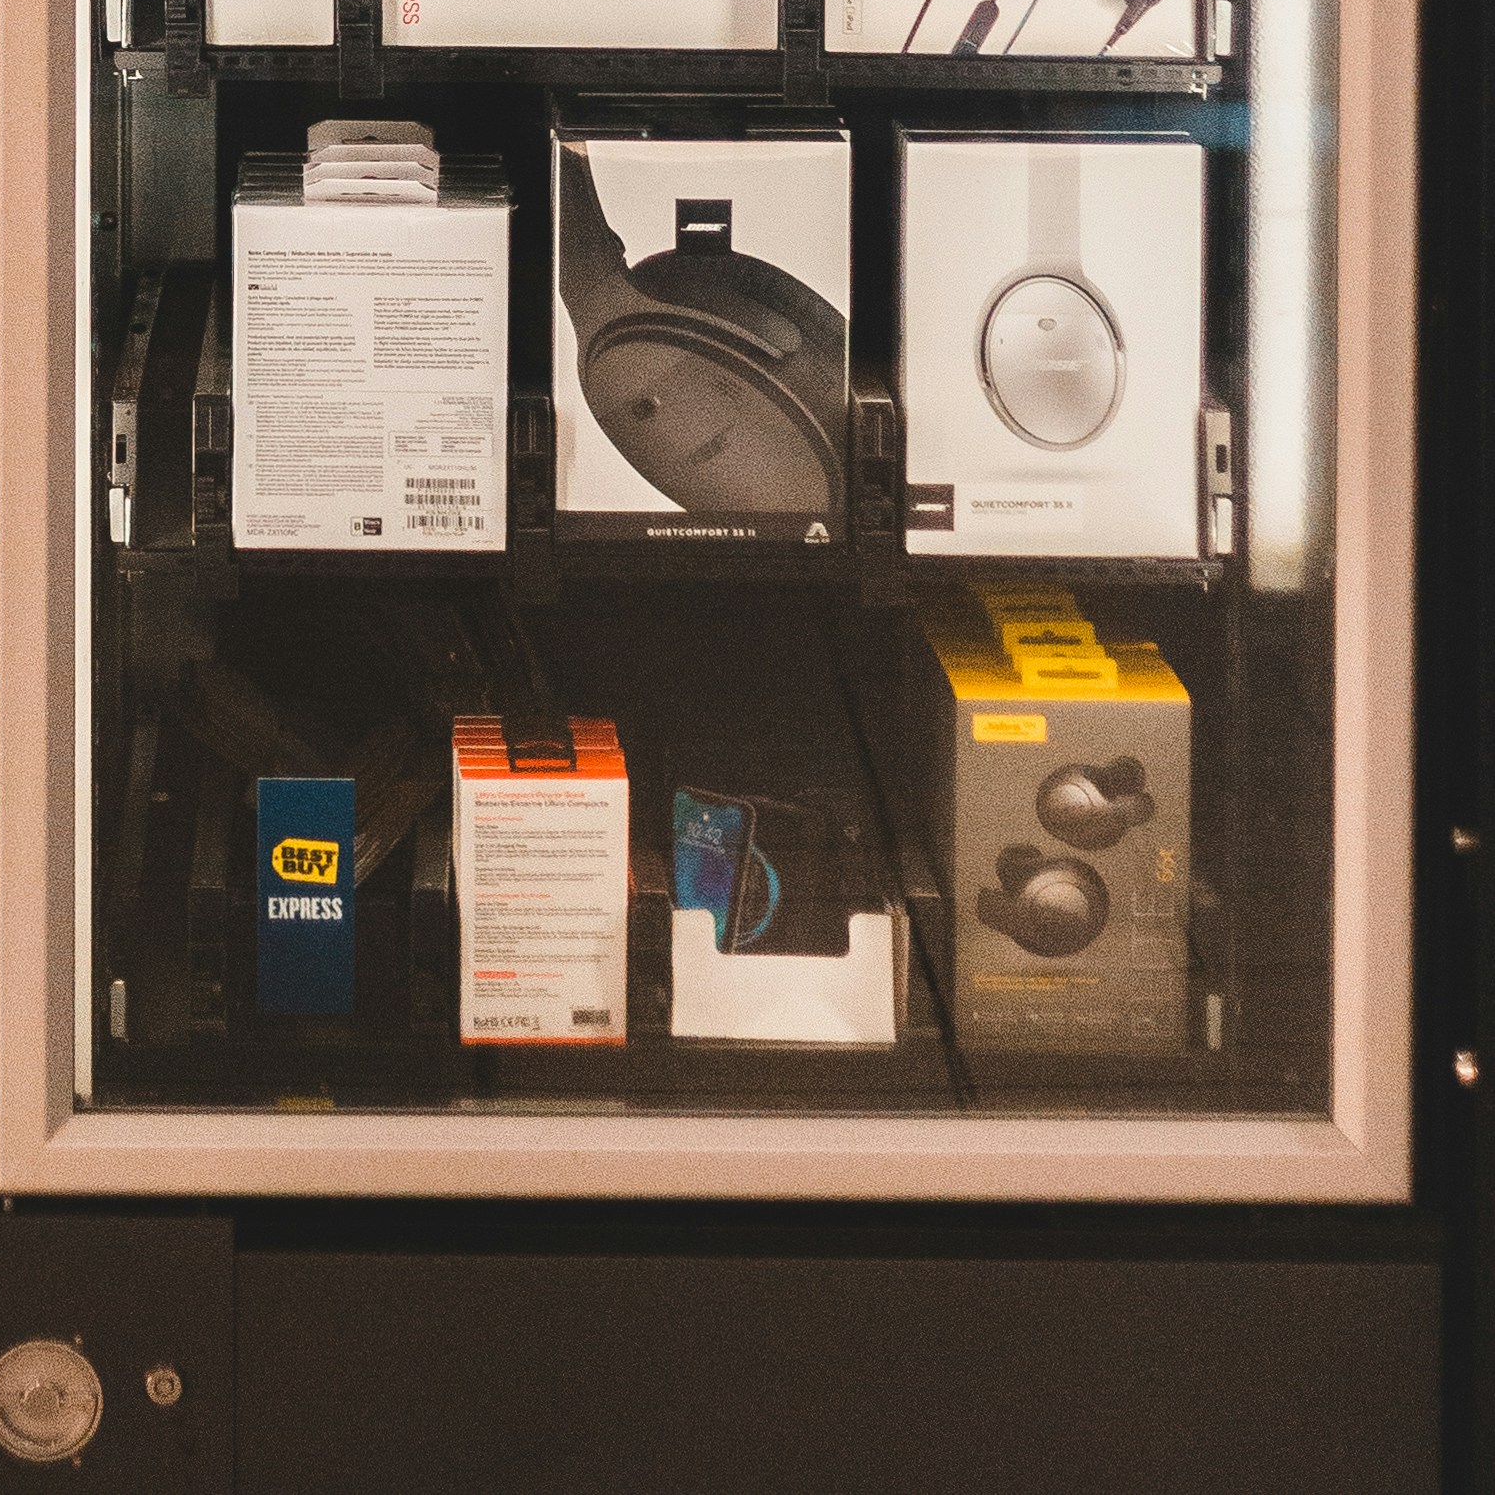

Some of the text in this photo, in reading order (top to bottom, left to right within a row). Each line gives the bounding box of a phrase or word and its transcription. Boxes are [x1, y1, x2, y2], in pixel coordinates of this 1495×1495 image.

[971, 500, 1050, 508] QUIETCOMFORT
[647, 529, 729, 537] QUIETCOMFORT
[281, 846, 336, 865] BEST
[281, 861, 331, 876] BUY
[268, 898, 343, 920] EXPRESS
